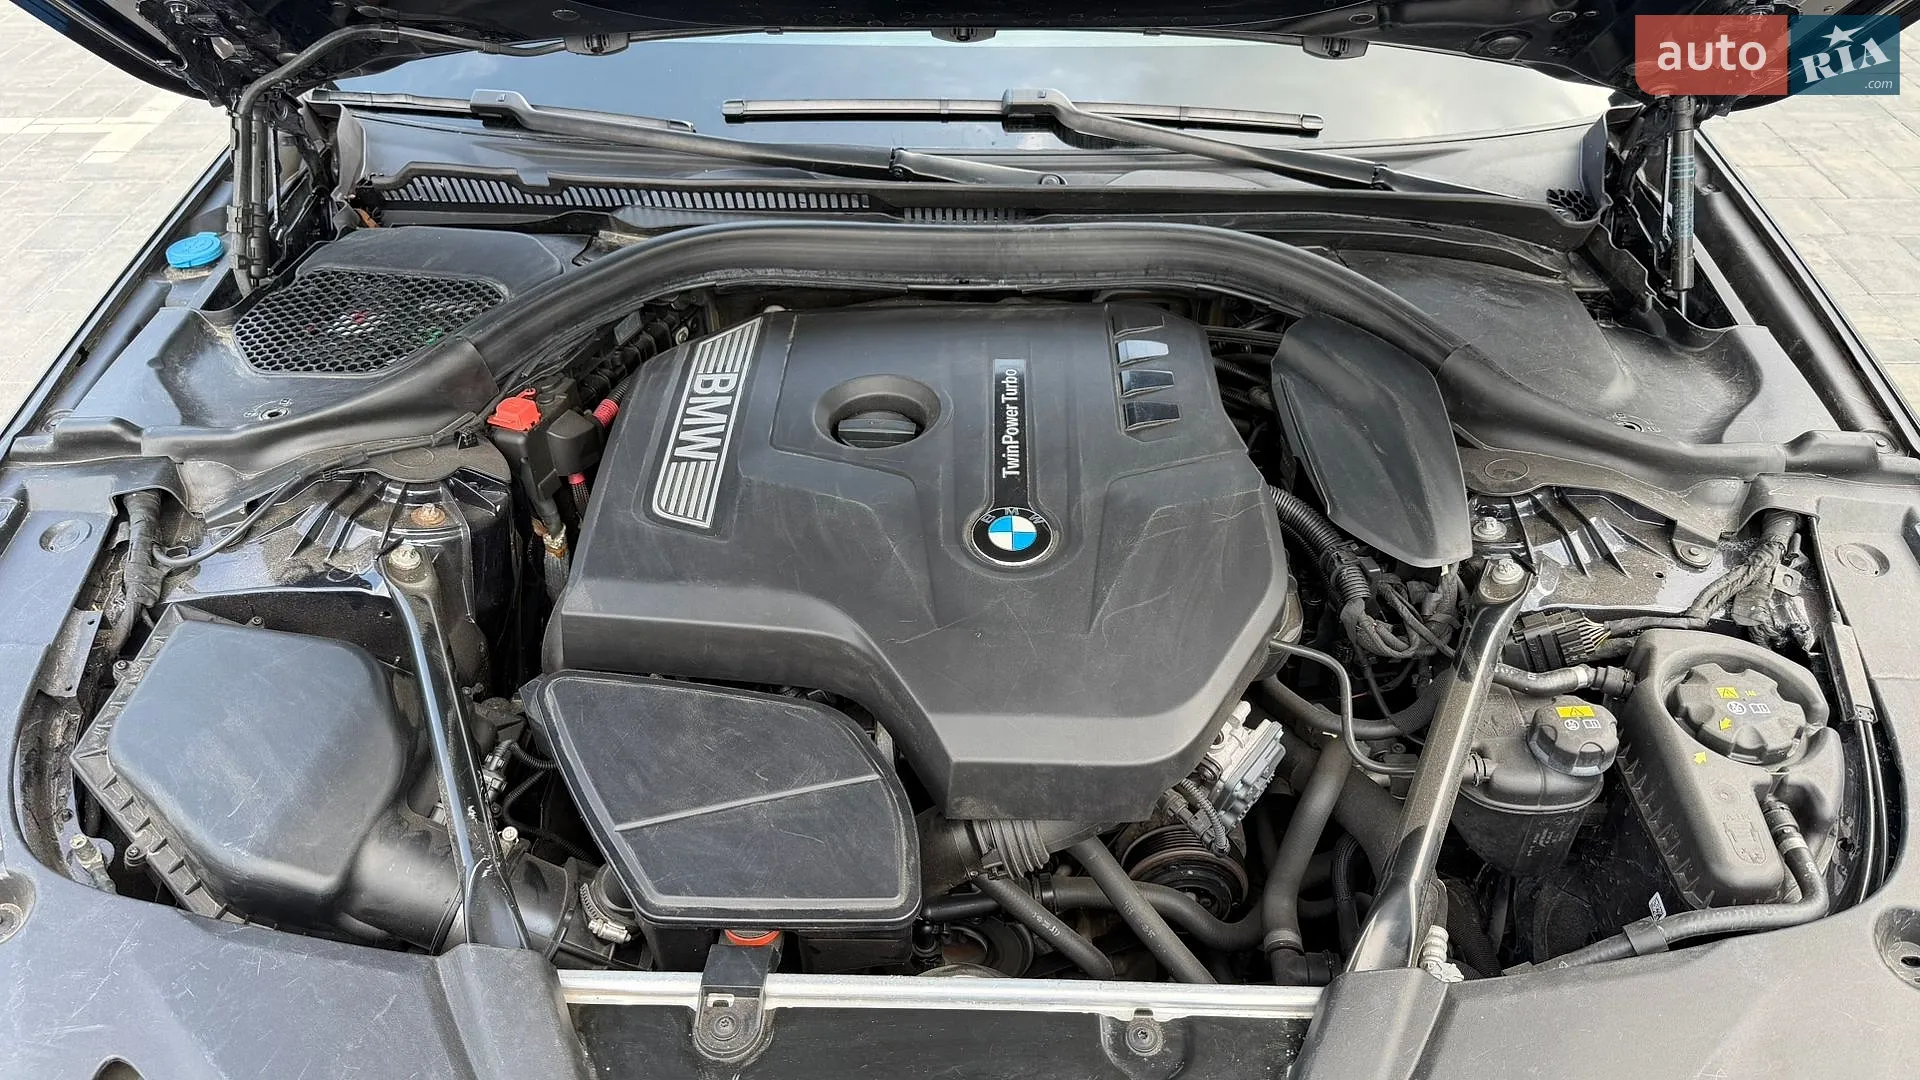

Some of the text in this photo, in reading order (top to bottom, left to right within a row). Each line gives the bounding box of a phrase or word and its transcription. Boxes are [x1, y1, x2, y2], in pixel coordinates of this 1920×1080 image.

[673, 373, 739, 461] BMW
[1001, 368, 1020, 479] TwinPower Turbo
[980, 506, 1045, 525] BMW
